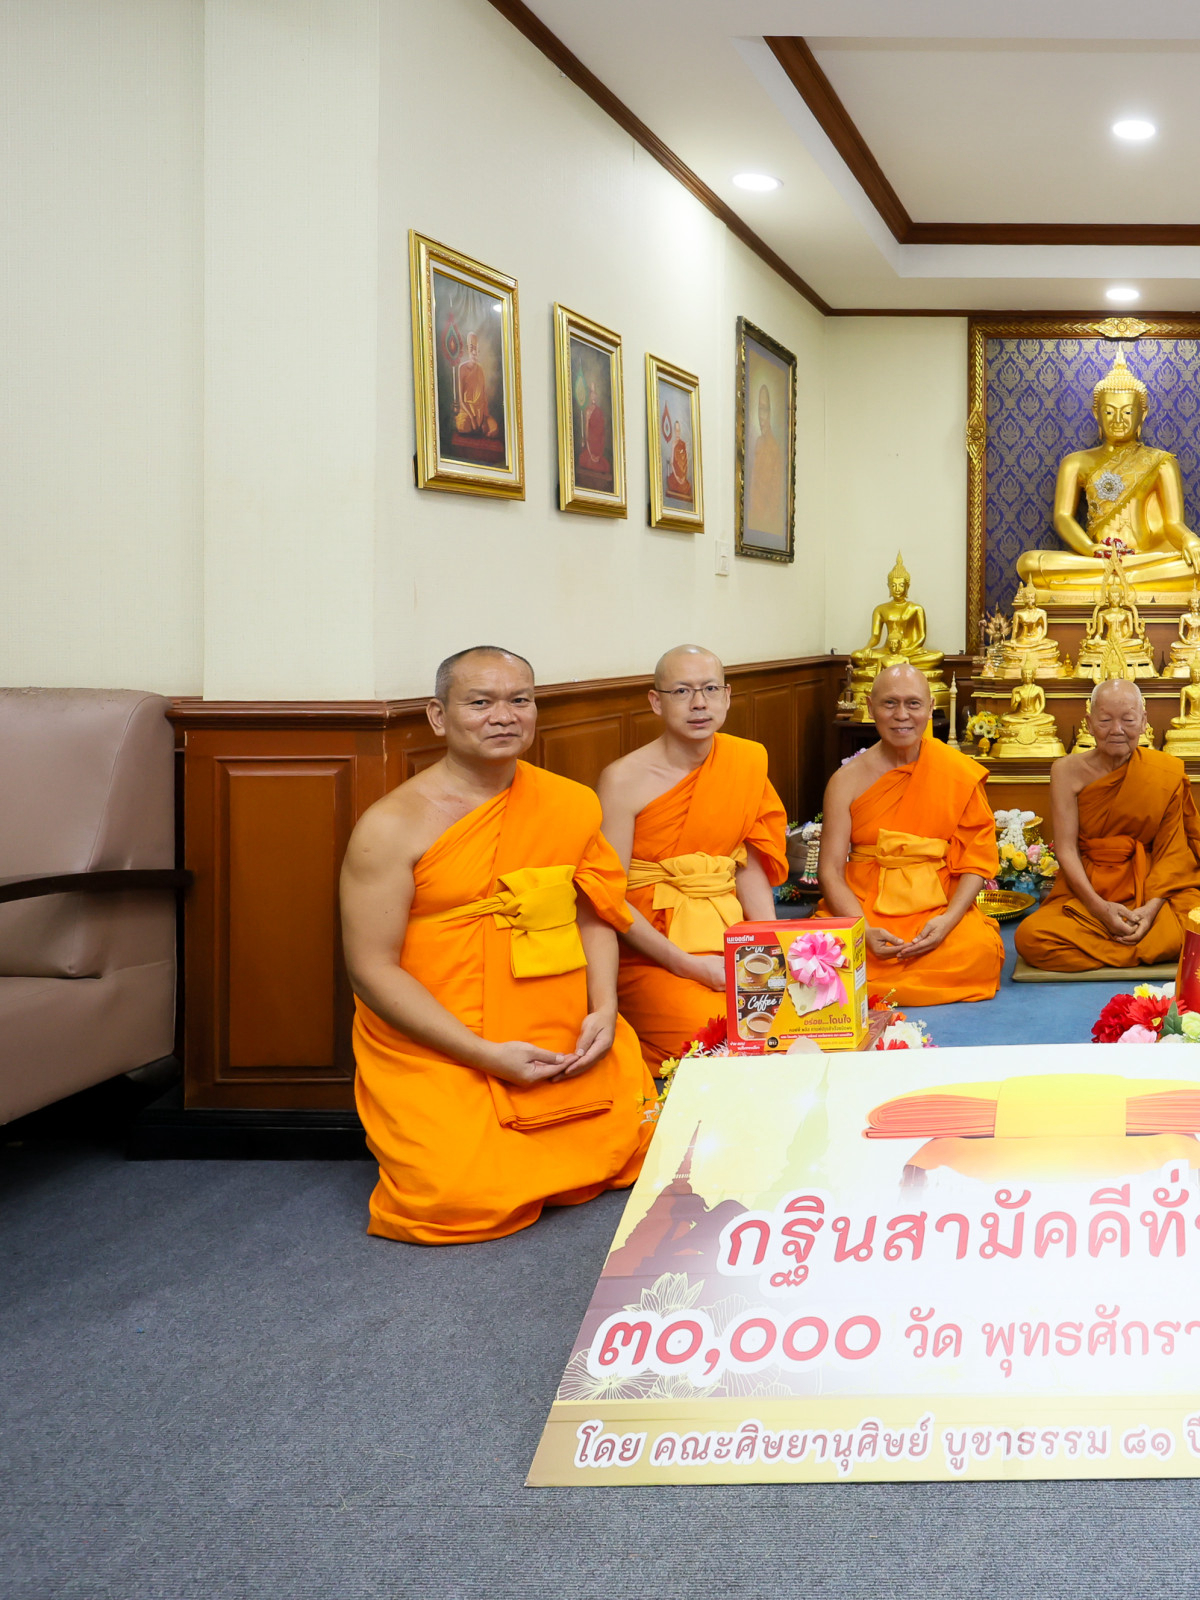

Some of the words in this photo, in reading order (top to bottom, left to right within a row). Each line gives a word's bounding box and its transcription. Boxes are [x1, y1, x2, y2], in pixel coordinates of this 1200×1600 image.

[747, 993, 777, 1011] Coffee
[598, 1315, 881, 1375] ๓๐,๐๐๐
[904, 1306, 963, 1359] วัด
[576, 1426, 642, 1464] โดย
[653, 1417, 931, 1471] คณะศิษยานุศิษย์
[944, 1432, 1108, 1472] บูชาธรรม
[1123, 1431, 1172, 1457] ๘๑
